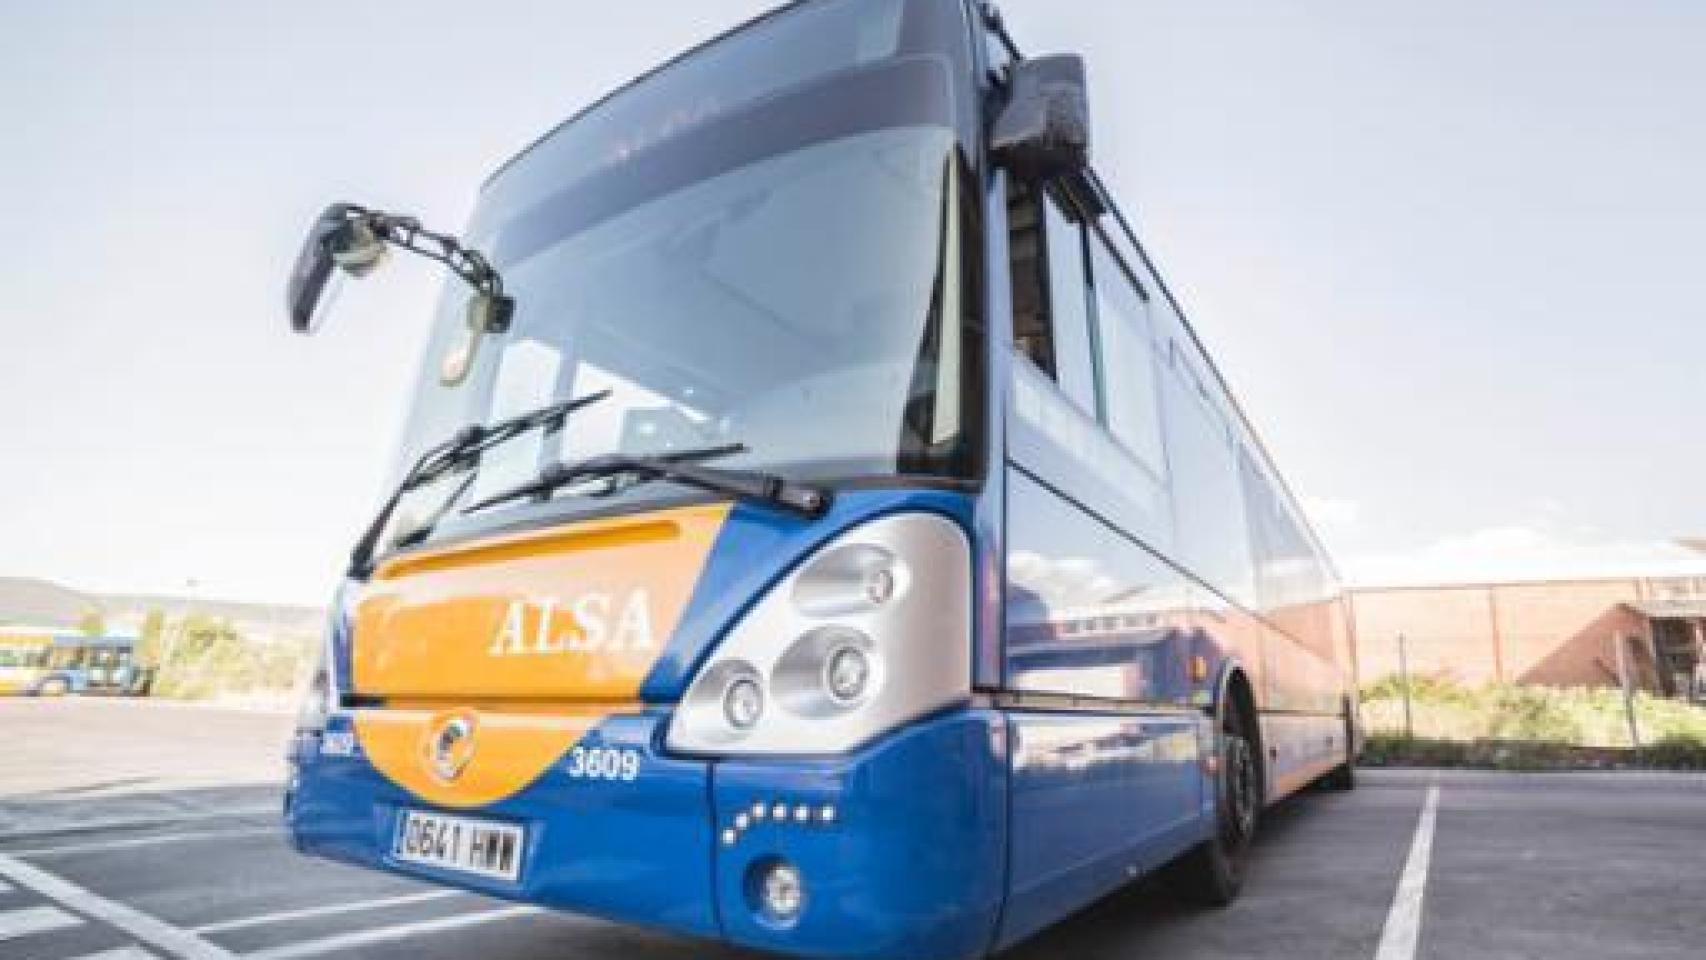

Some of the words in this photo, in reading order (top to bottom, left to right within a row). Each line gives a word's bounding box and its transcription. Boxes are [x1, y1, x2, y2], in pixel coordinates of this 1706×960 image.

[488, 588, 656, 655] ALSA
[568, 746, 639, 781] 3609
[406, 817, 460, 864] 0641
